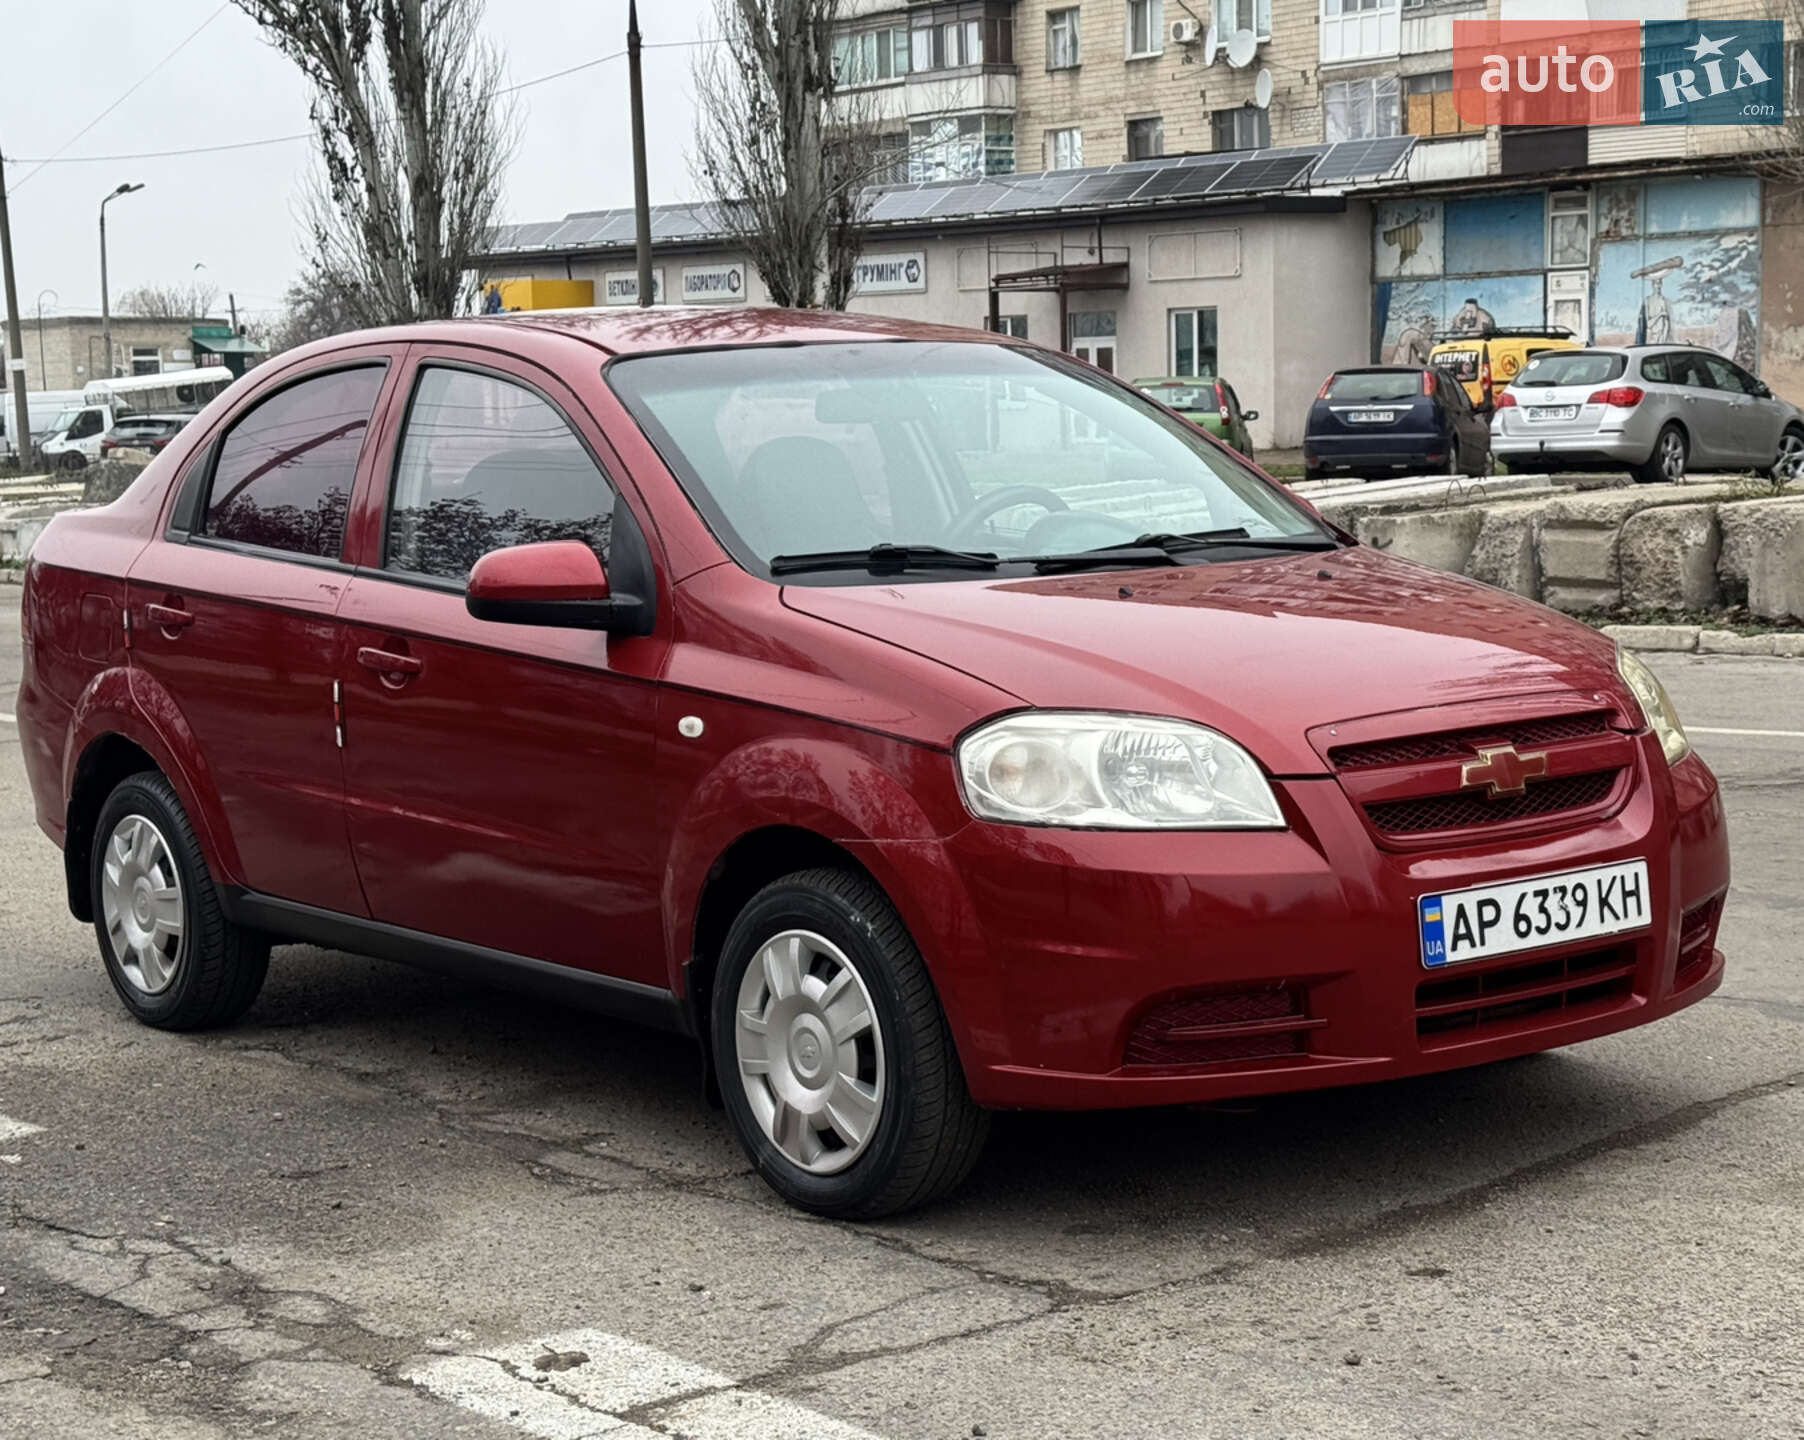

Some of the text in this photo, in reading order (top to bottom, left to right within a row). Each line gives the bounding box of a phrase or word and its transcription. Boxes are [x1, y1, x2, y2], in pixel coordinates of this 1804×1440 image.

[856, 262, 905, 283] ГРУМІНГ
[1450, 871, 1643, 952] AP 6339 KH
[1426, 939, 1445, 955] UA
